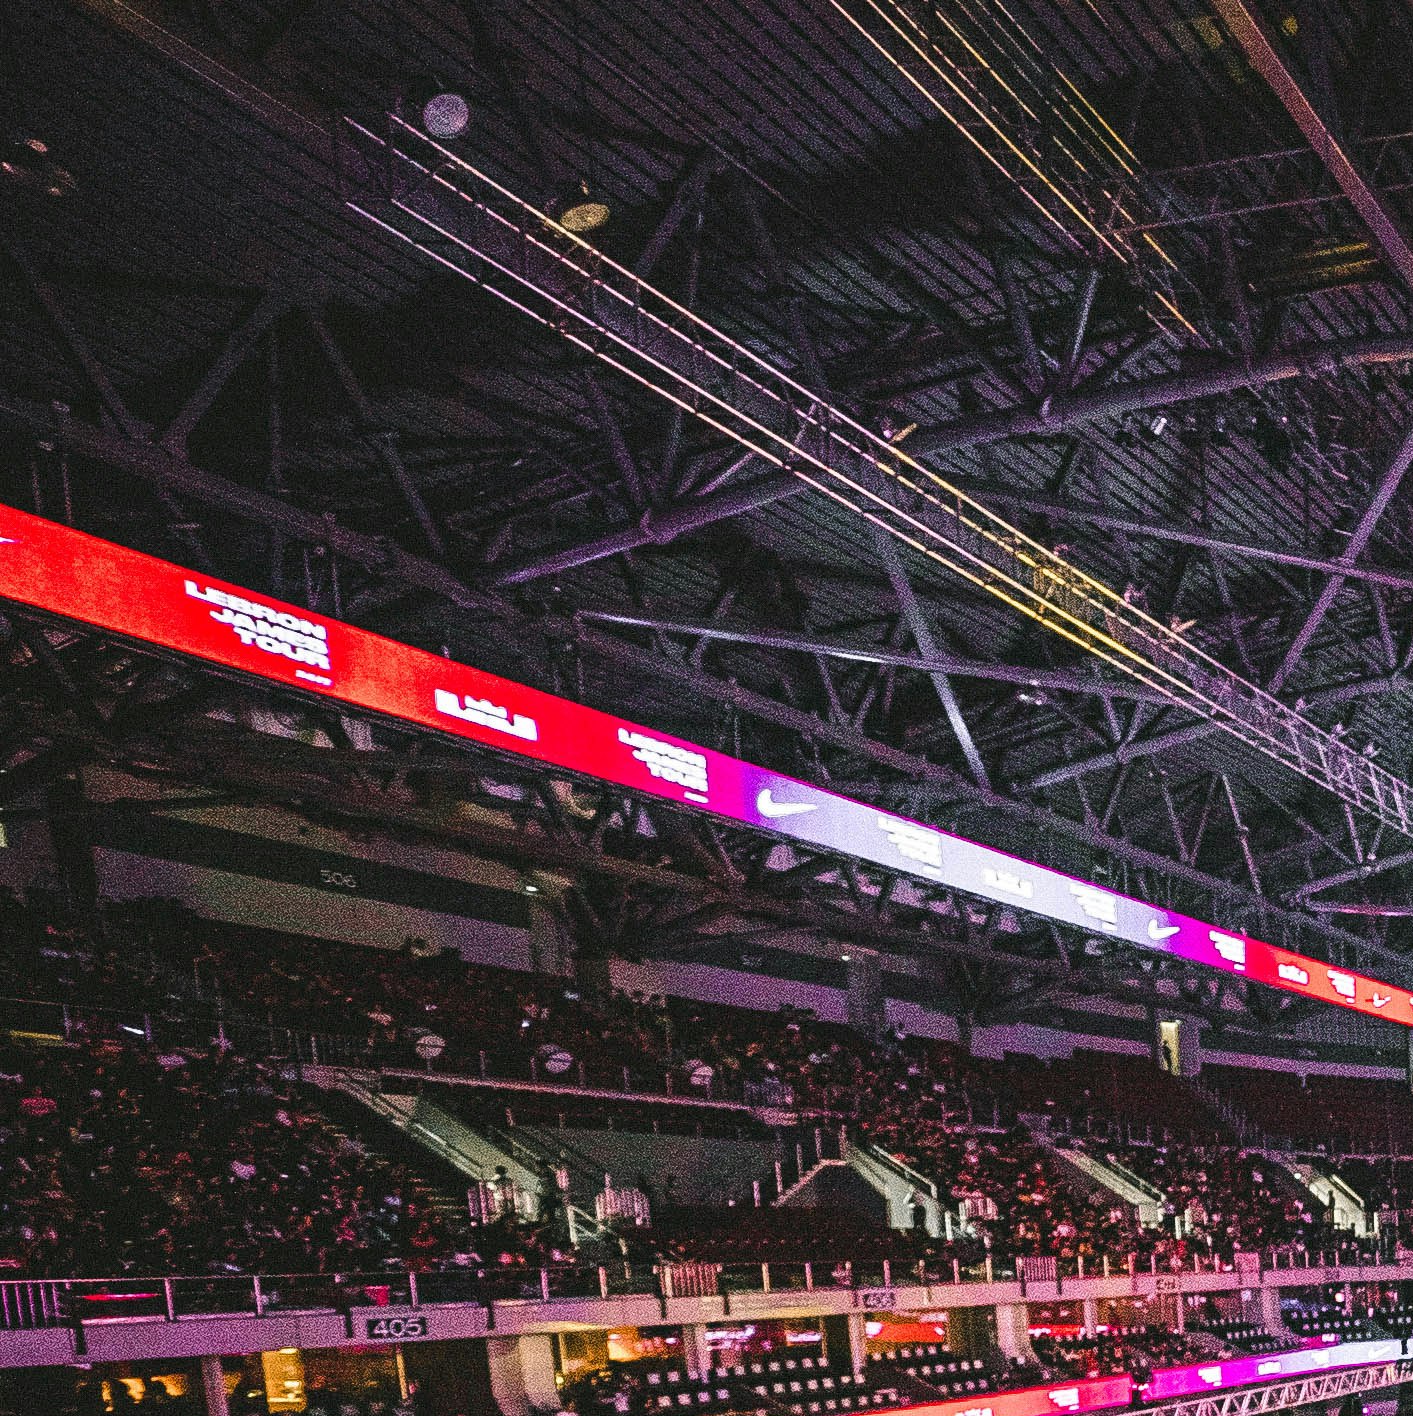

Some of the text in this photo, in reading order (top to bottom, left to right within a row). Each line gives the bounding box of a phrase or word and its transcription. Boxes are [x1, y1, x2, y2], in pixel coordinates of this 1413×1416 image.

[184, 580, 326, 640] LEBRON
[210, 608, 328, 654] JAMES
[233, 626, 330, 670] TOUR
[374, 1318, 422, 1337] 405
